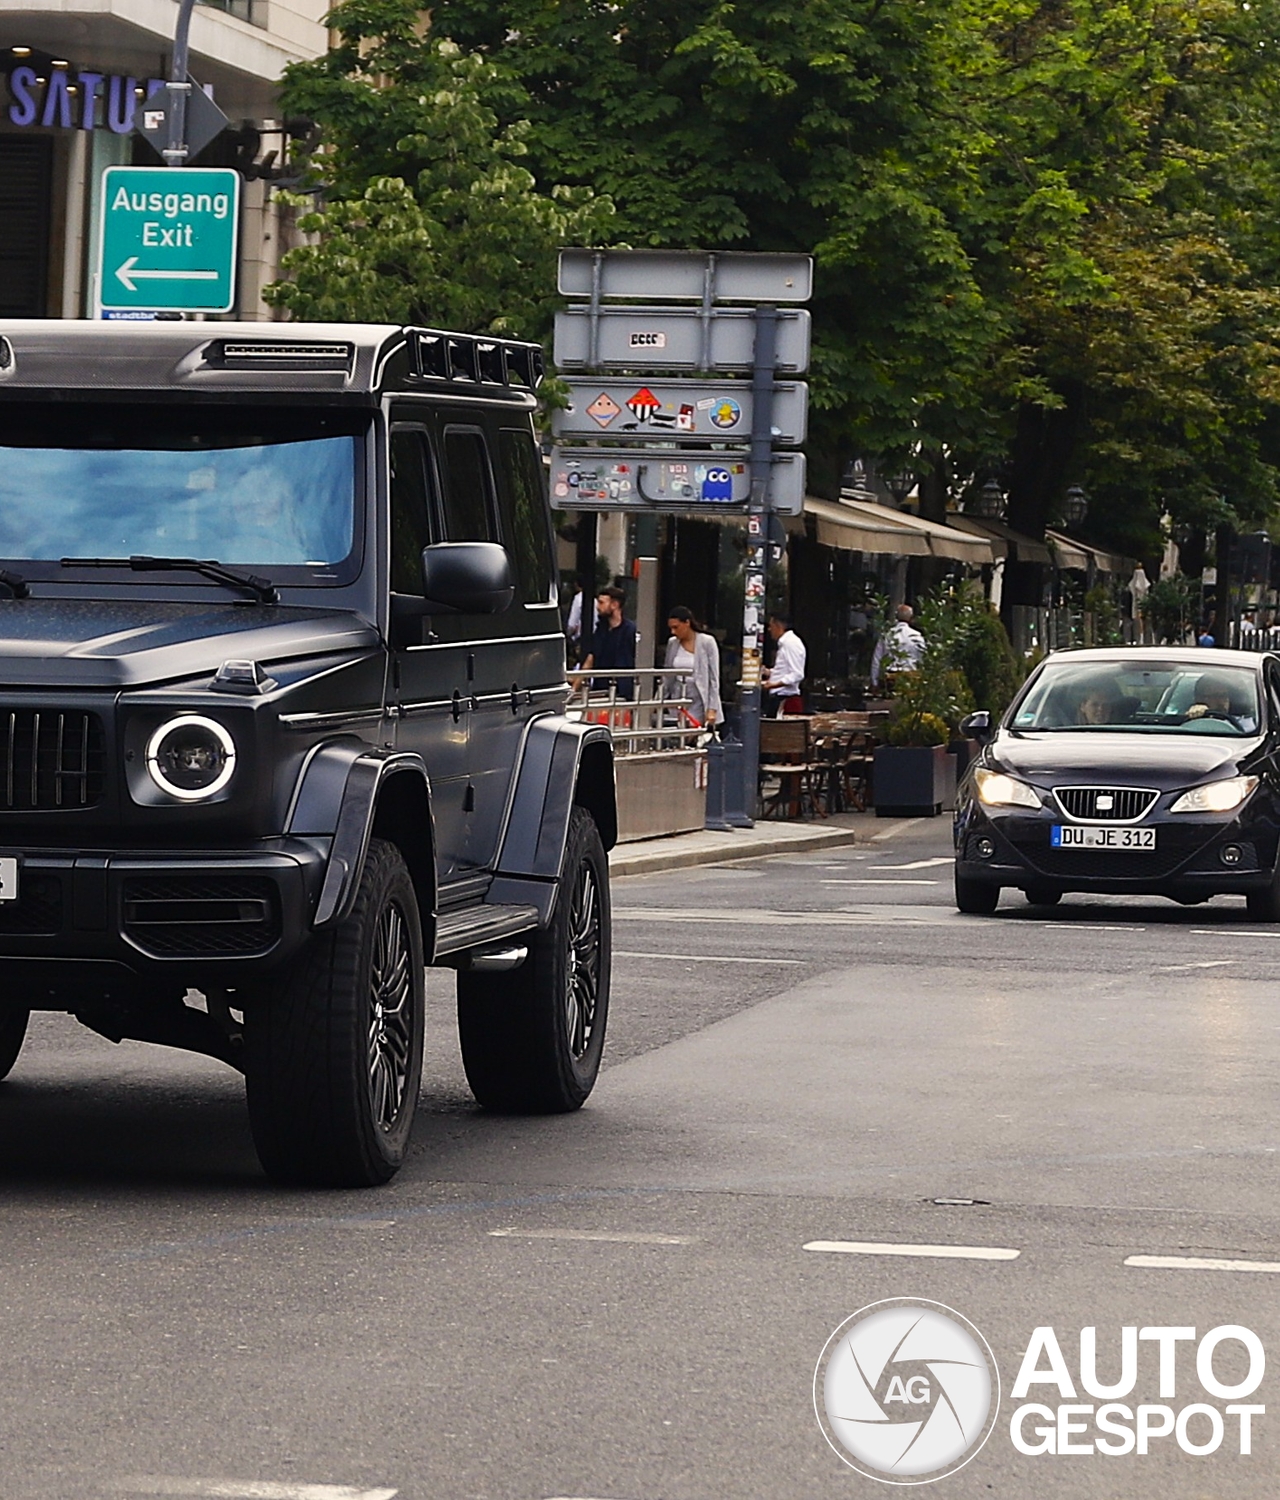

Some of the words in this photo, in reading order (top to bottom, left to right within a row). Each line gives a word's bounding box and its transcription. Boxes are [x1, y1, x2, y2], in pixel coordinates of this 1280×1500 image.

[9, 66, 213, 133] SATU
[111, 186, 228, 219] Ausgang
[142, 222, 193, 247] Exit
[1062, 829, 1084, 844] DU
[1095, 830, 1117, 846] JE
[1122, 830, 1154, 847] 312
